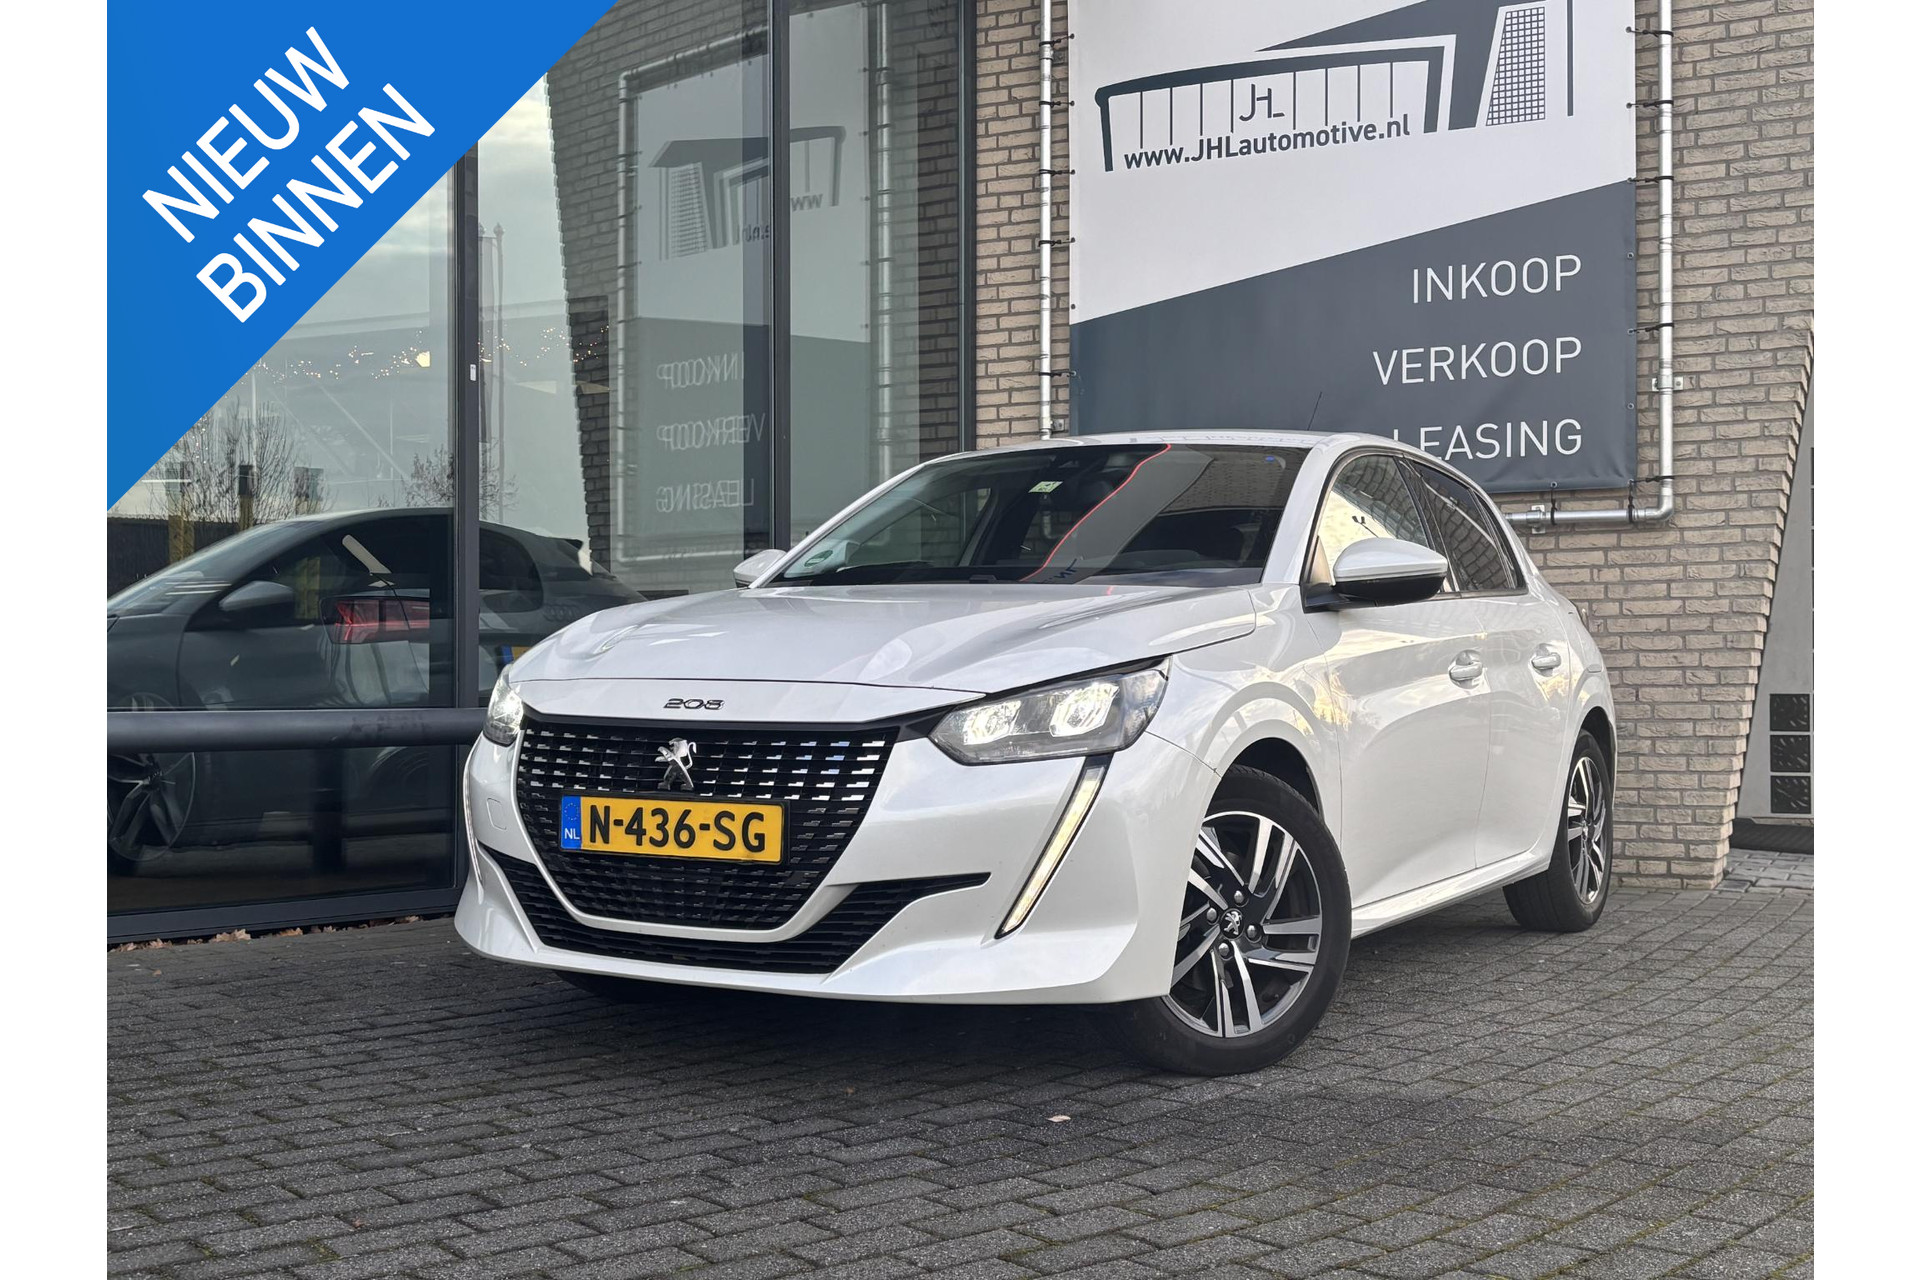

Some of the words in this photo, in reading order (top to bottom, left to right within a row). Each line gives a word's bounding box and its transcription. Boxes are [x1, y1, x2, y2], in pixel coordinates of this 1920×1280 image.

[1124, 113, 1410, 169] www.JHLautomotive.nl
[1413, 254, 1582, 304] INKOOP
[1373, 336, 1582, 386] VERKOOP
[663, 698, 725, 710] 208
[564, 828, 580, 840] NL
[589, 804, 766, 853] N-436-SG
